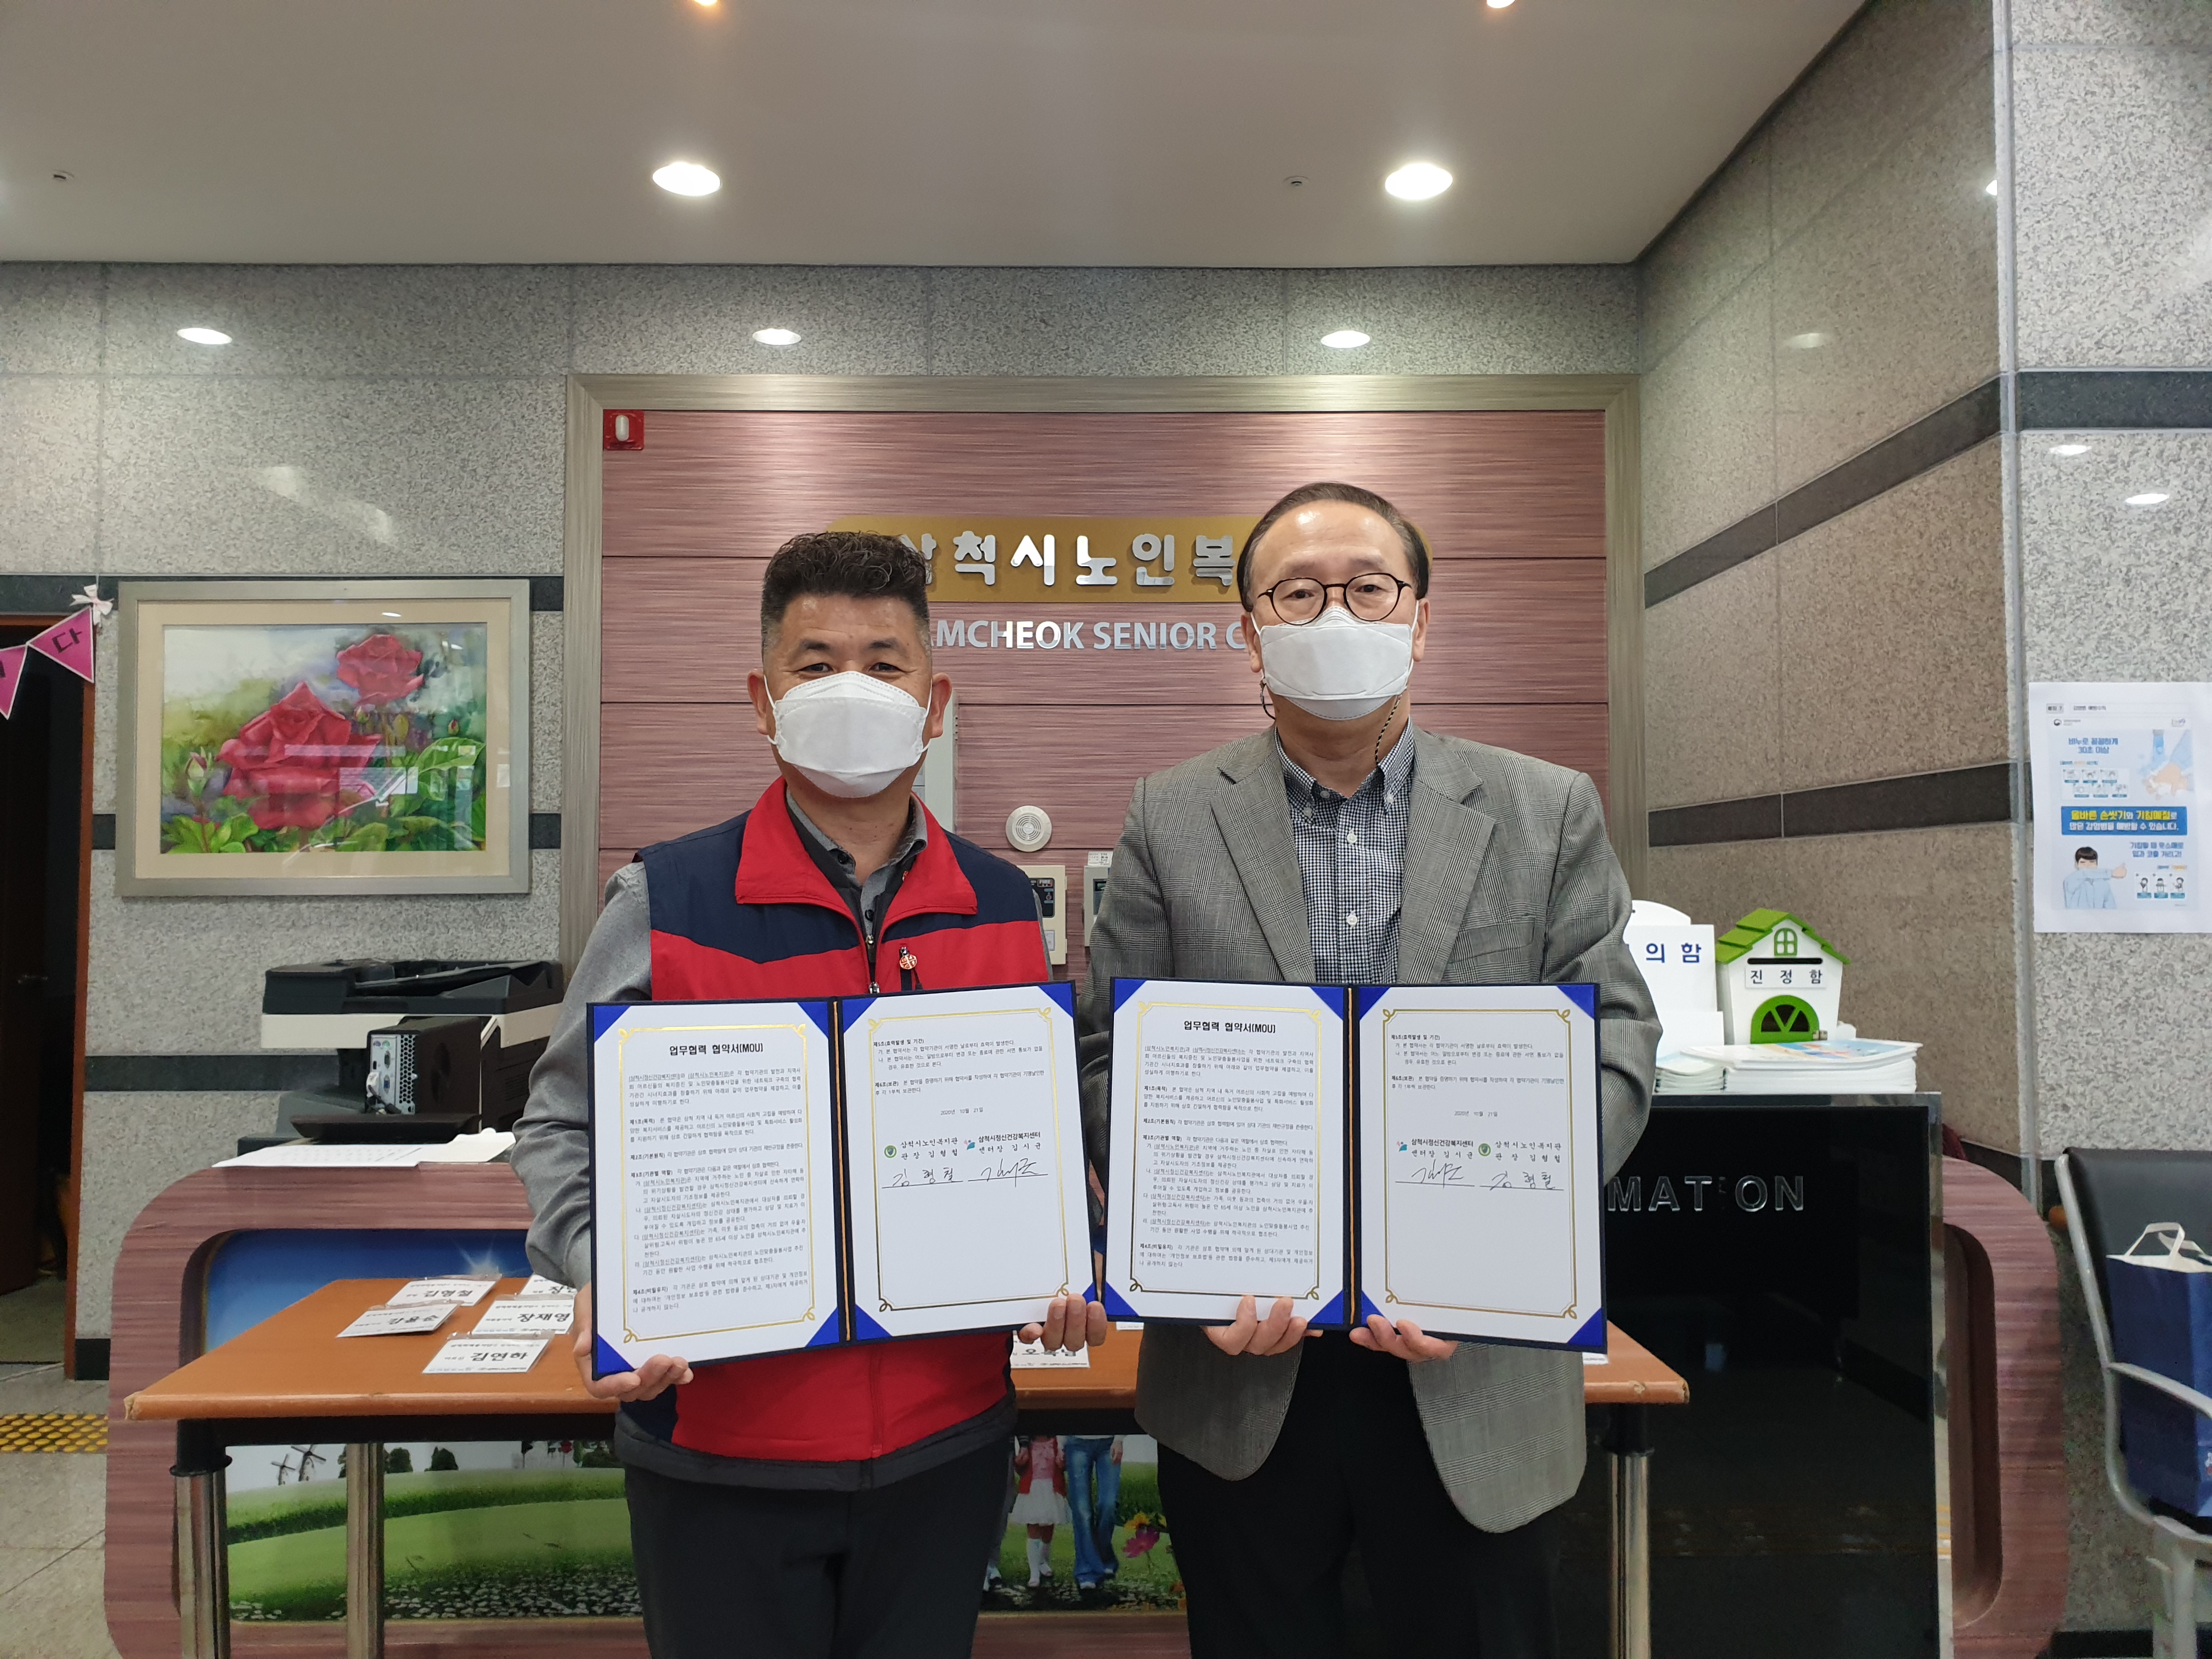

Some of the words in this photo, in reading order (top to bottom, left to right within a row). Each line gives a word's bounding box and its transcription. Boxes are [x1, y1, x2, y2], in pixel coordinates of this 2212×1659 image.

[932, 619, 1084, 650] MCHEOK
[1093, 621, 1217, 650] SENIOR
[1225, 621, 1247, 650] C
[1626, 943, 1702, 963] 의함
[1750, 969, 1822, 985] 진정함
[1184, 1020, 1219, 1031] 업무협력
[1224, 1022, 1276, 1034] 협약서(MOU)
[669, 1045, 707, 1056] 업무협력
[712, 1042, 763, 1054] 협약서(MOU)
[978, 1131, 1041, 1143] 삼척시정신건강복지센터
[1607, 1175, 1804, 1212] MATON
[517, 1313, 571, 1322] 장재영
[470, 1352, 528, 1361] 김연하
